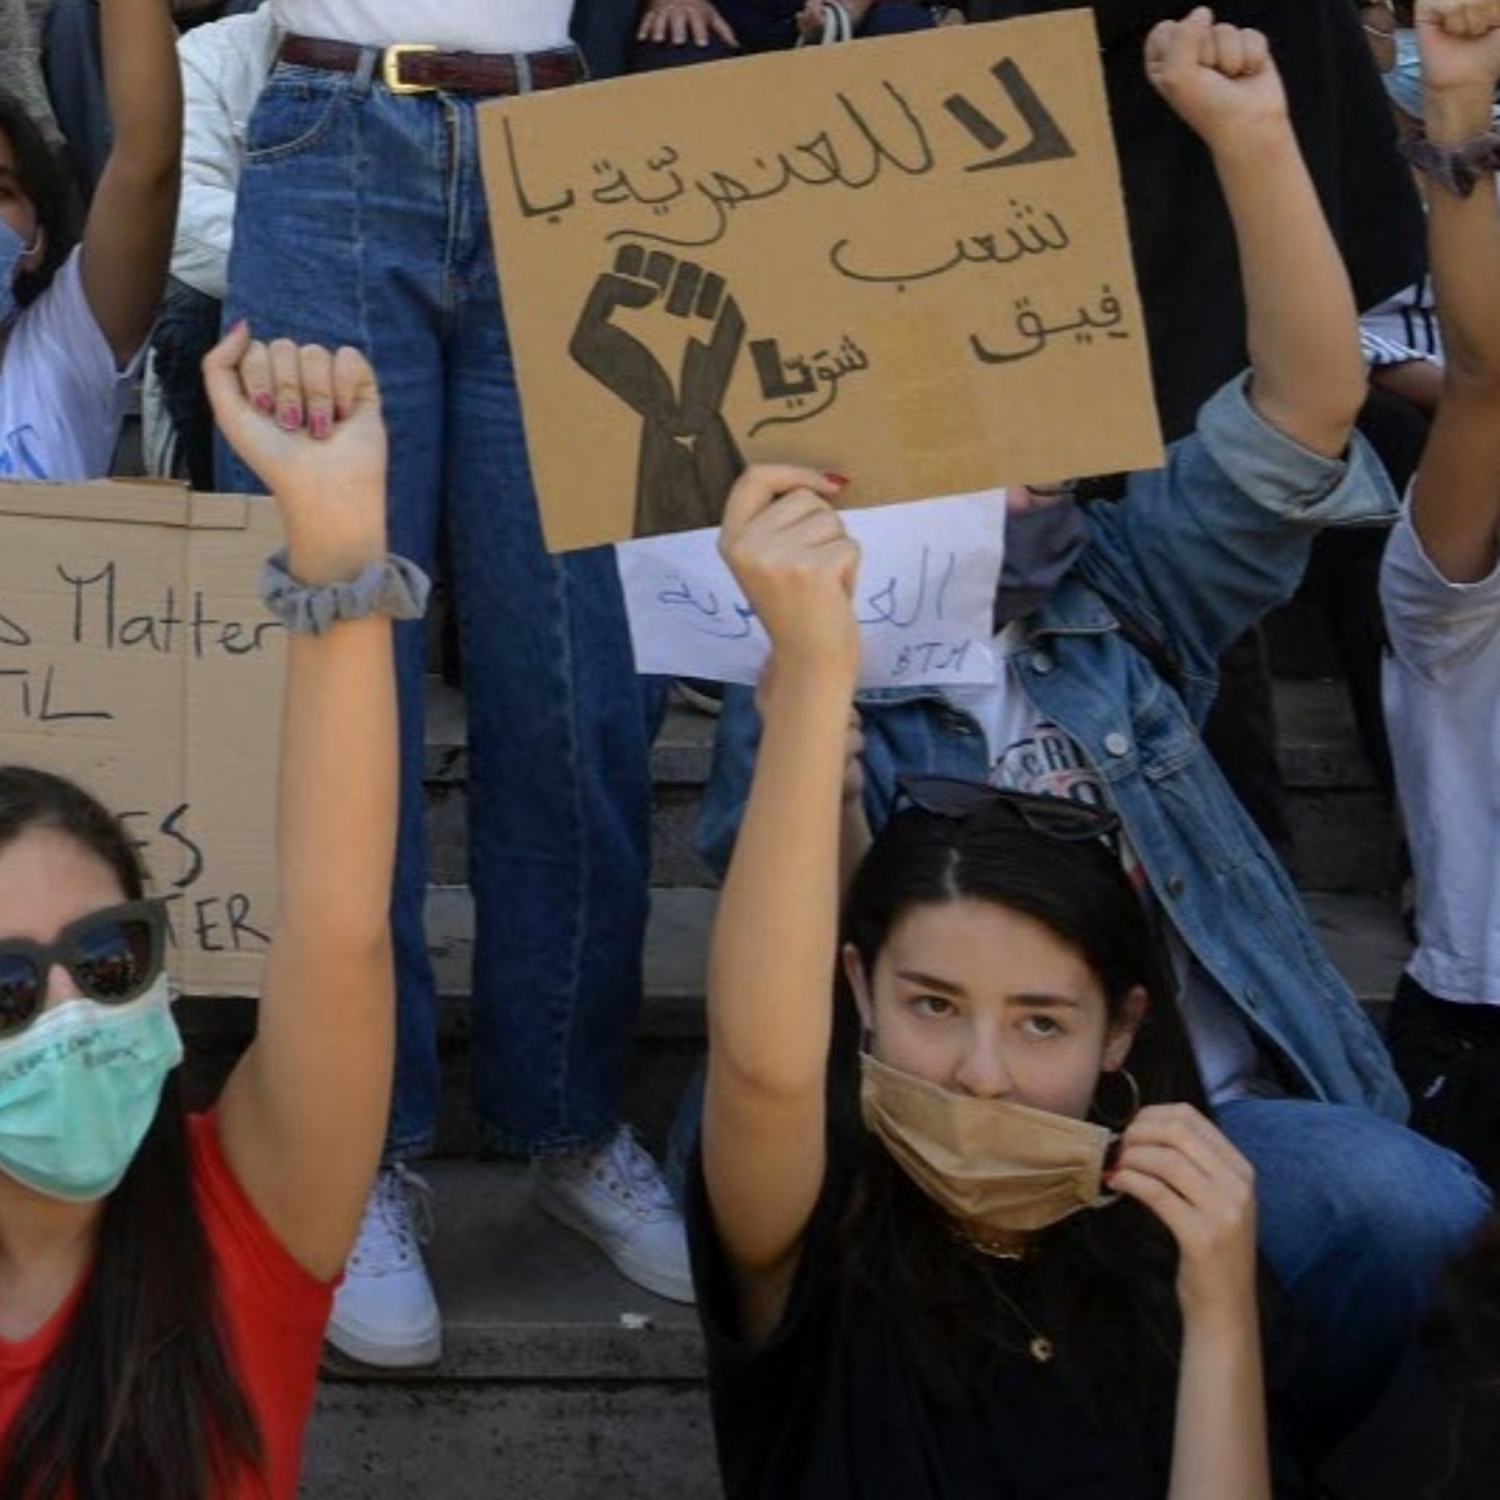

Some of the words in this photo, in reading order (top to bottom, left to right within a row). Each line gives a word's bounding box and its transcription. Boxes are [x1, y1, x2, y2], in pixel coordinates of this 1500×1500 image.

[943, 55, 1078, 173] لا
[829, 197, 1071, 292] شعب
[56, 561, 284, 658] Matter
